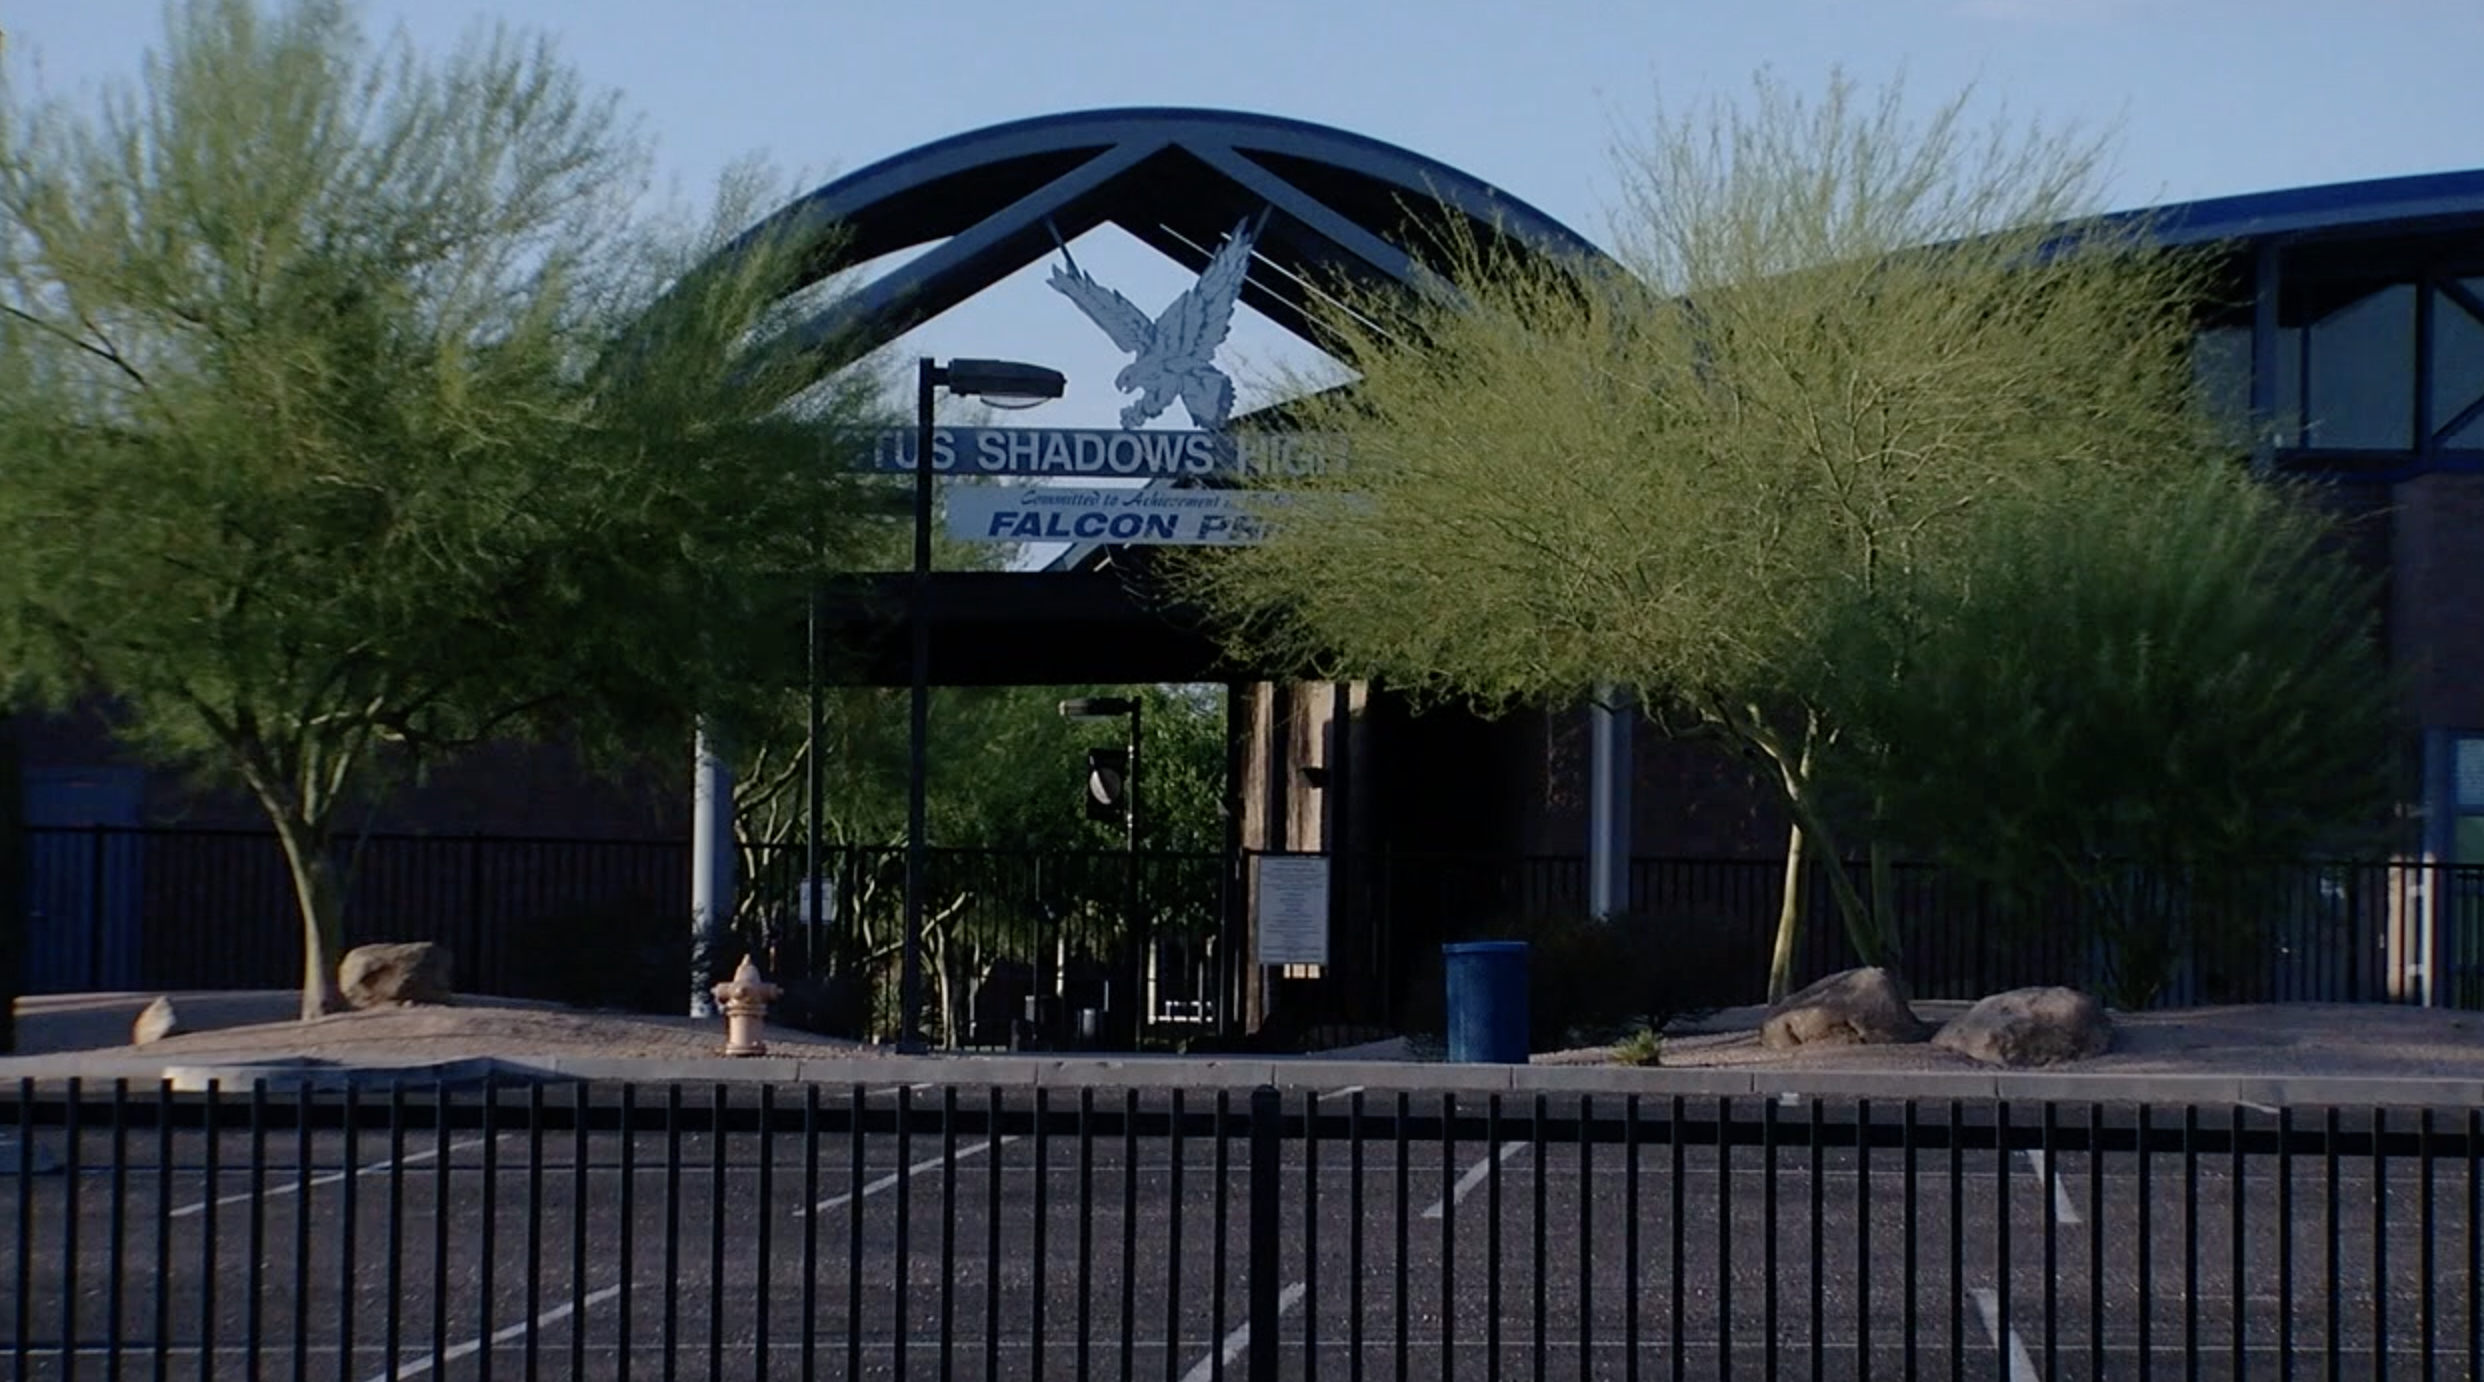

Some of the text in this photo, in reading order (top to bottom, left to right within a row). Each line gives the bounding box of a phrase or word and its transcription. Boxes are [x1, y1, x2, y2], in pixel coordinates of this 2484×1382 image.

[976, 430, 1215, 475] SHADOWS
[1020, 489, 1101, 507] Committed
[1103, 493, 1120, 507] to
[1122, 490, 1221, 509] Achievement
[987, 511, 1179, 540] FALCON
